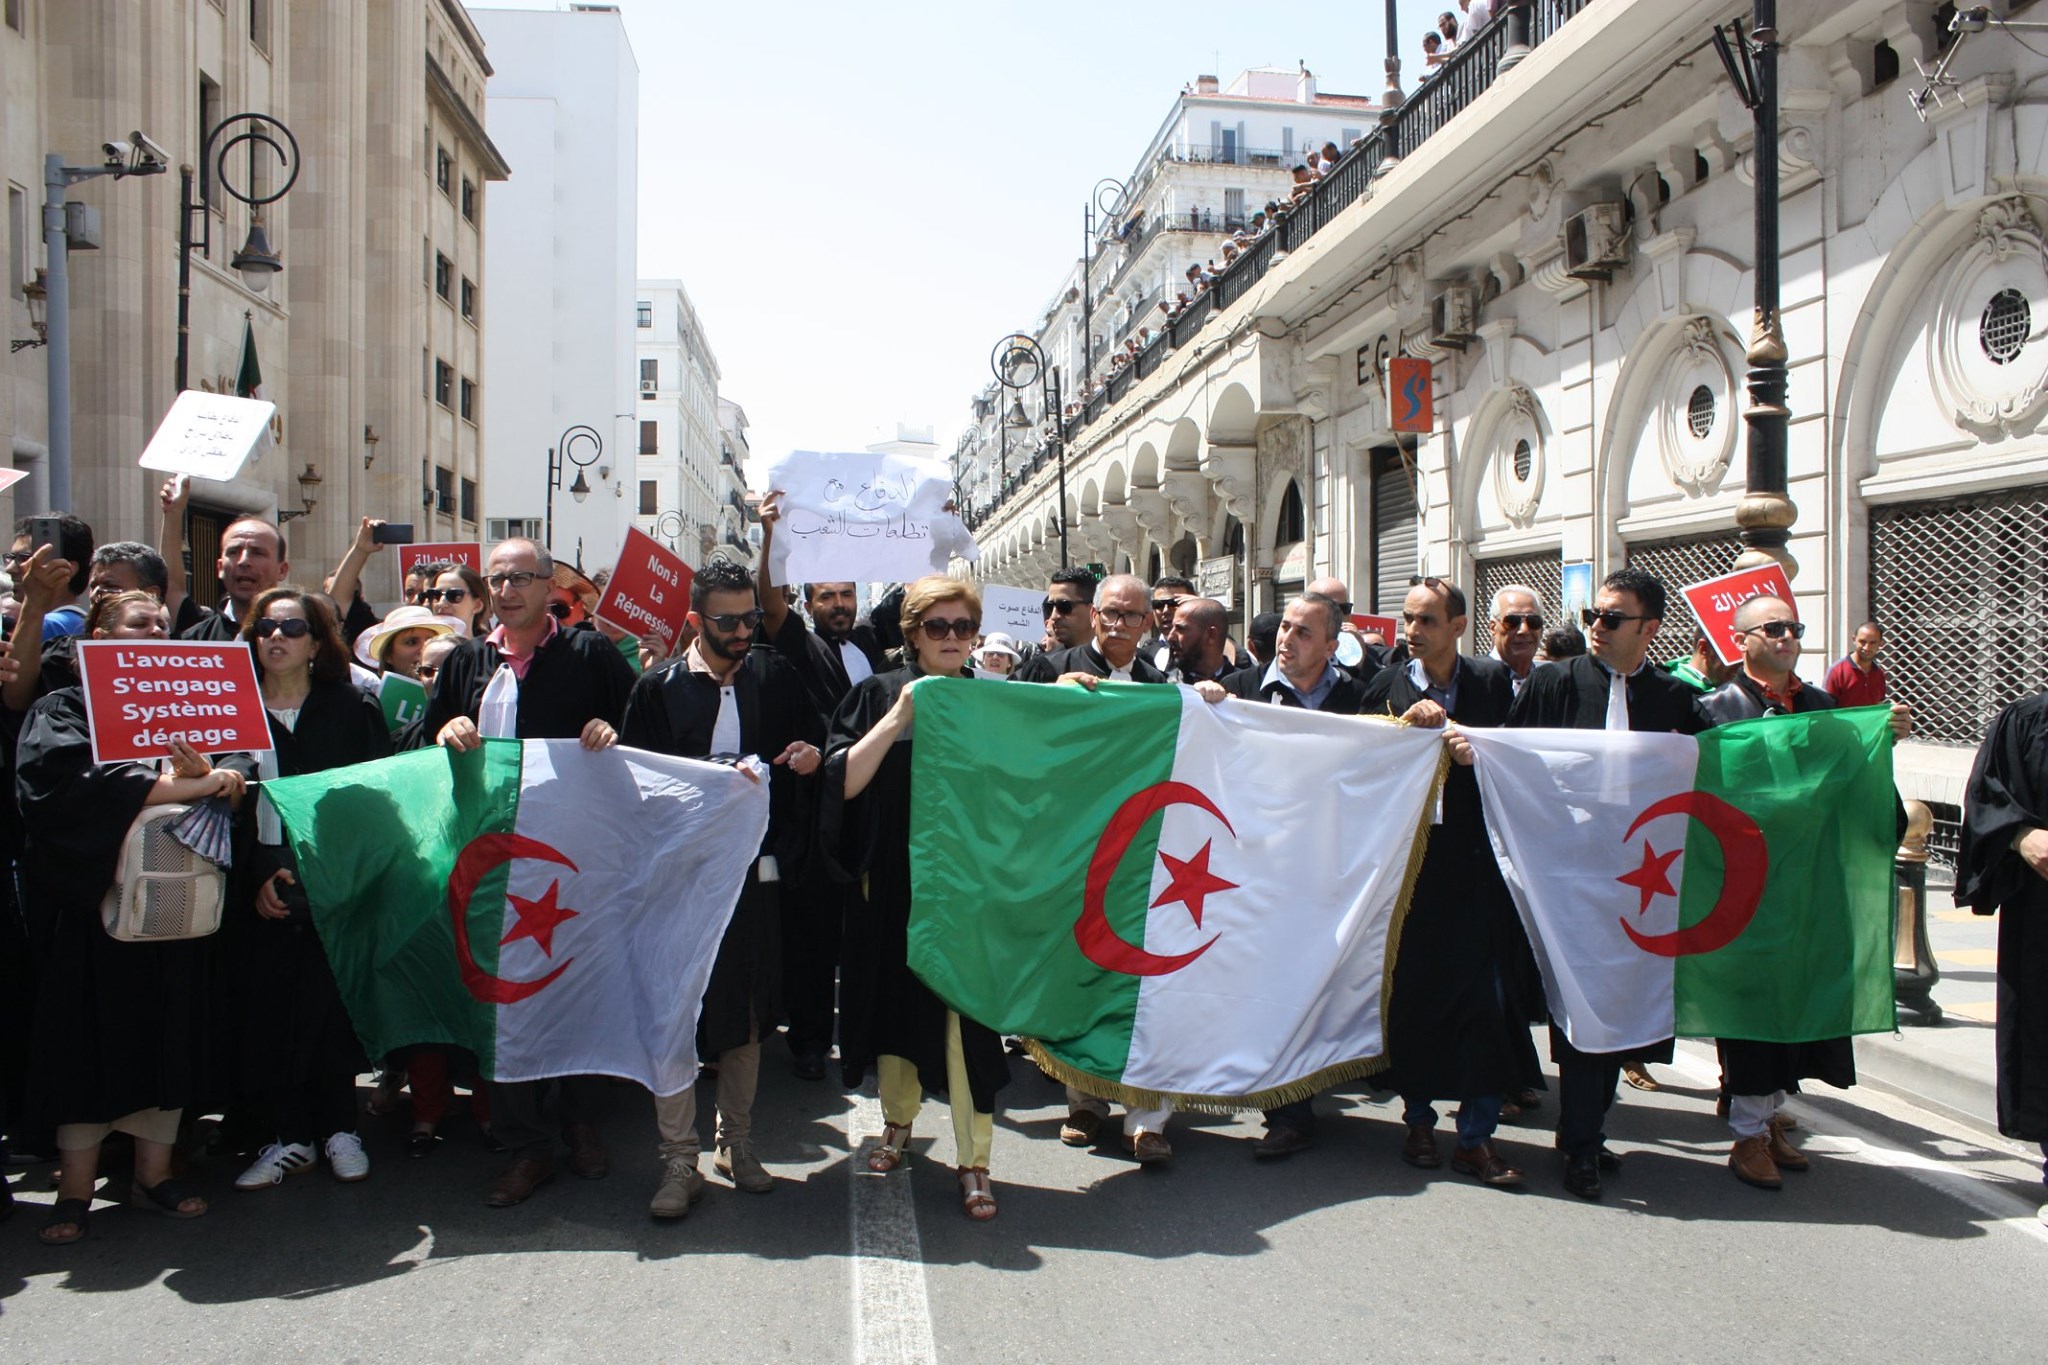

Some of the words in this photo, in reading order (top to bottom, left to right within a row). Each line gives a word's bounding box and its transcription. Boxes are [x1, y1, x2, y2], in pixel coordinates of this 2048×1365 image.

[823, 478, 844, 502] مع
[854, 468, 917, 511] الدفاع
[791, 509, 847, 539] الشعب
[647, 554, 671, 582] Non
[671, 571, 679, 587] à
[649, 584, 664, 605] La
[613, 592, 674, 641] Répression
[998, 603, 1019, 613] صوت
[116, 652, 225, 668] L'avocat
[112, 677, 236, 696] S'engage
[122, 702, 238, 724] Système
[132, 727, 237, 748] dégage
